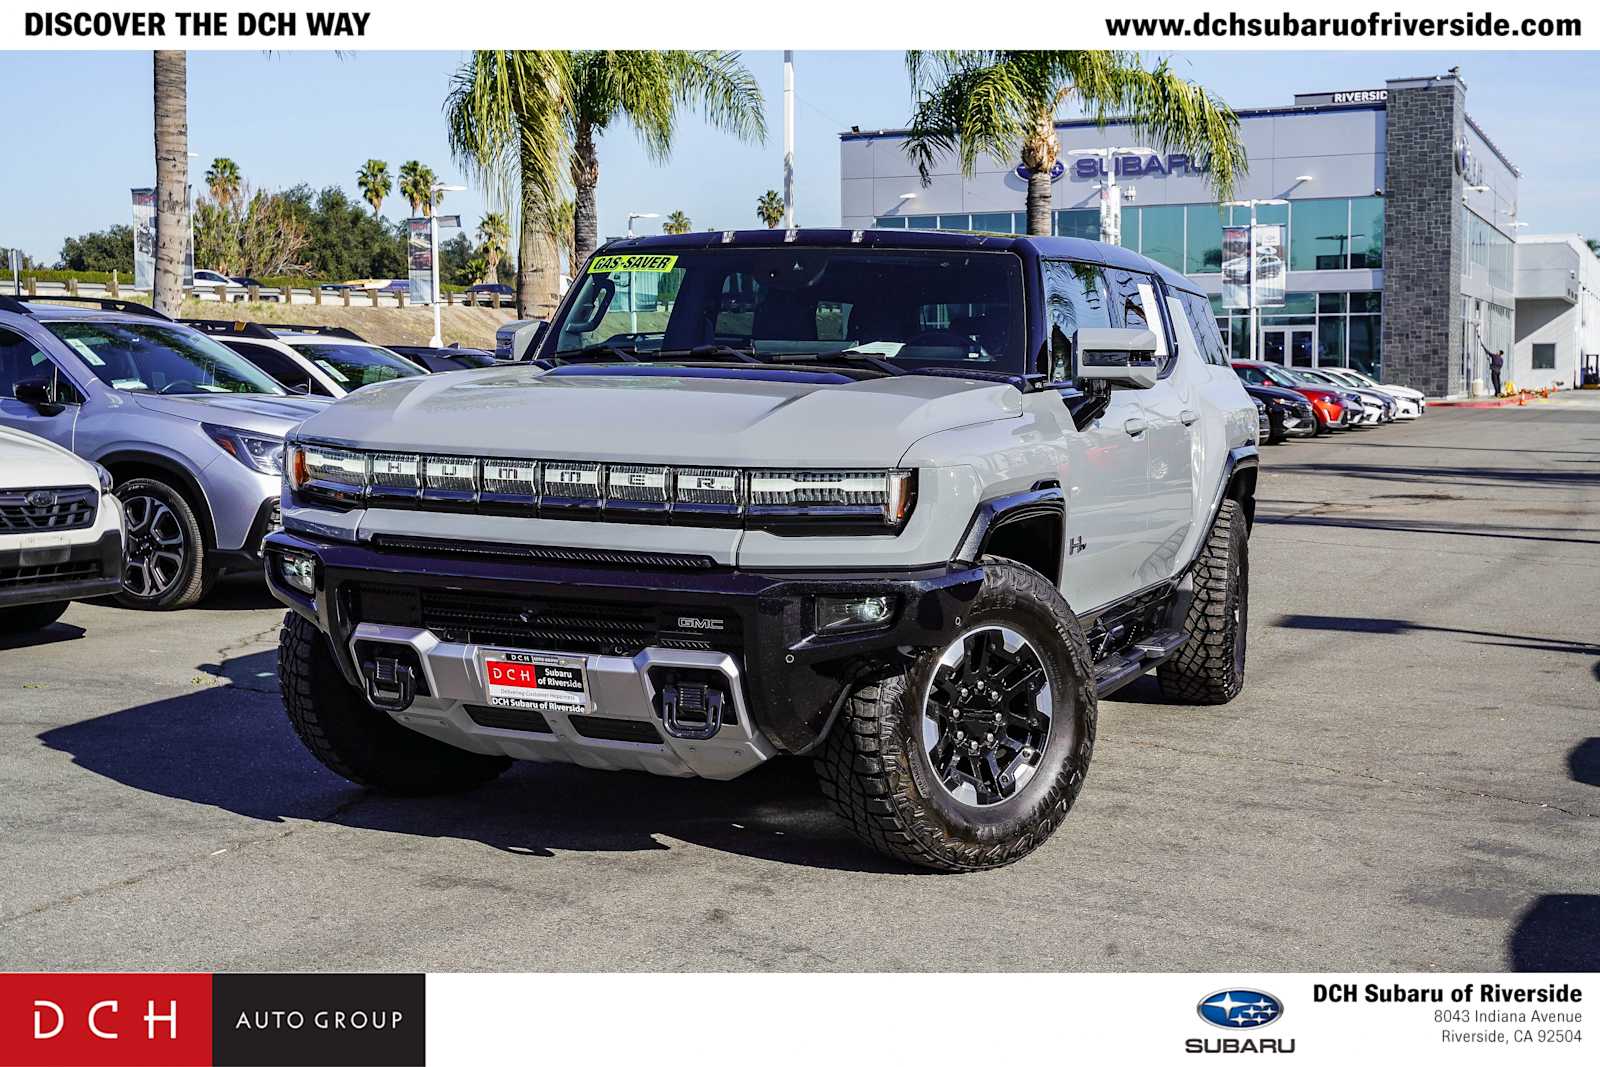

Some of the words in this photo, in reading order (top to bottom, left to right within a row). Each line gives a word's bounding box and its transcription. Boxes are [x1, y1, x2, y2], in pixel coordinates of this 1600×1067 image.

[593, 256, 671, 270] GAS-SAVER
[387, 461, 716, 489] HUMMER
[678, 617, 724, 630] GMC
[493, 667, 531, 682] DCH
[544, 668, 573, 678] Subaru
[547, 678, 583, 689] Riverside
[492, 697, 509, 706] DCH
[510, 699, 538, 709] Subaru
[539, 701, 548, 710] of
[548, 702, 585, 713] Riverside
